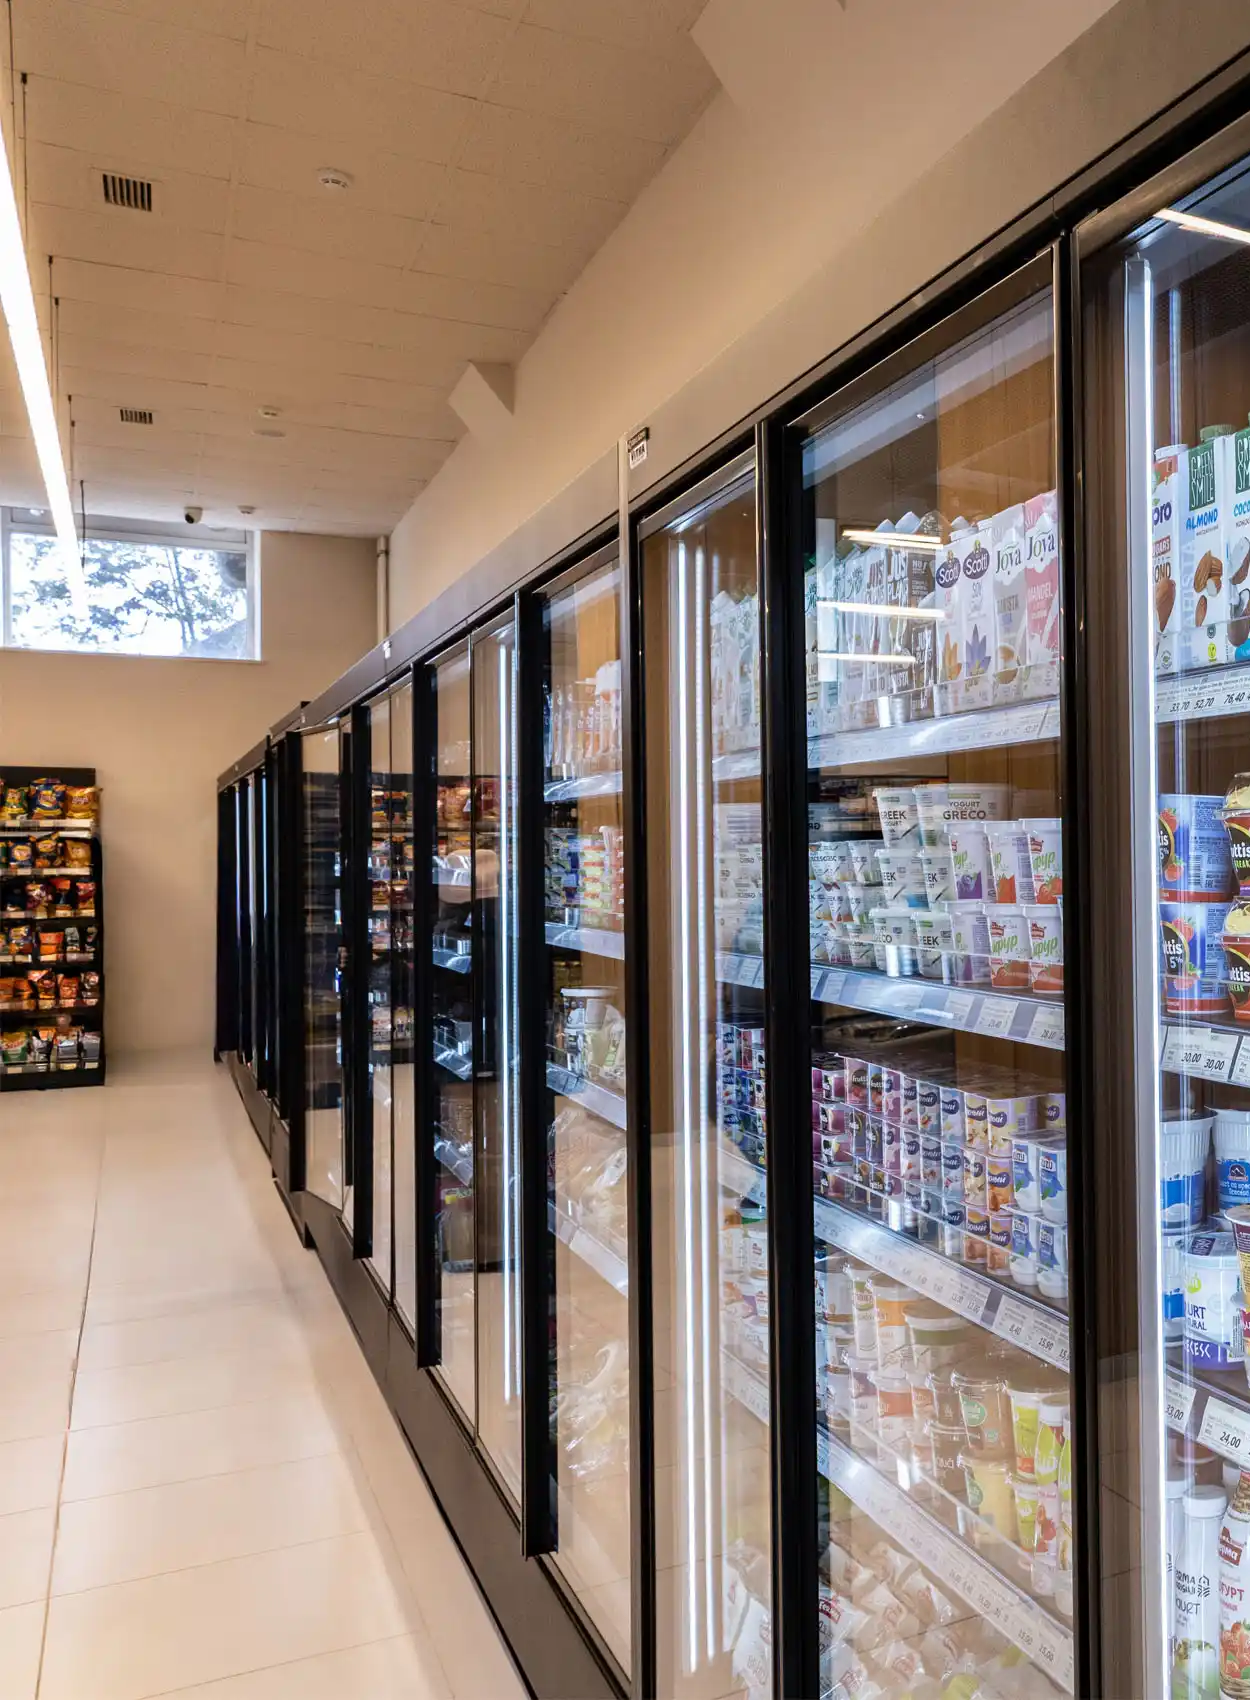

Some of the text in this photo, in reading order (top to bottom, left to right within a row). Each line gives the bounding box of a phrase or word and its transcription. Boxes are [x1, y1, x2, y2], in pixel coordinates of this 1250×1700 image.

[1190, 450, 1214, 479] GREEN
[1191, 473, 1215, 509] SMILE
[1186, 508, 1218, 531] ALMOND
[1028, 529, 1056, 562] Joya
[966, 553, 989, 574] Scotti
[995, 545, 1022, 576] Joya
[943, 810, 986, 821] GRECO
[1219, 1431, 1241, 1448] 24,00
